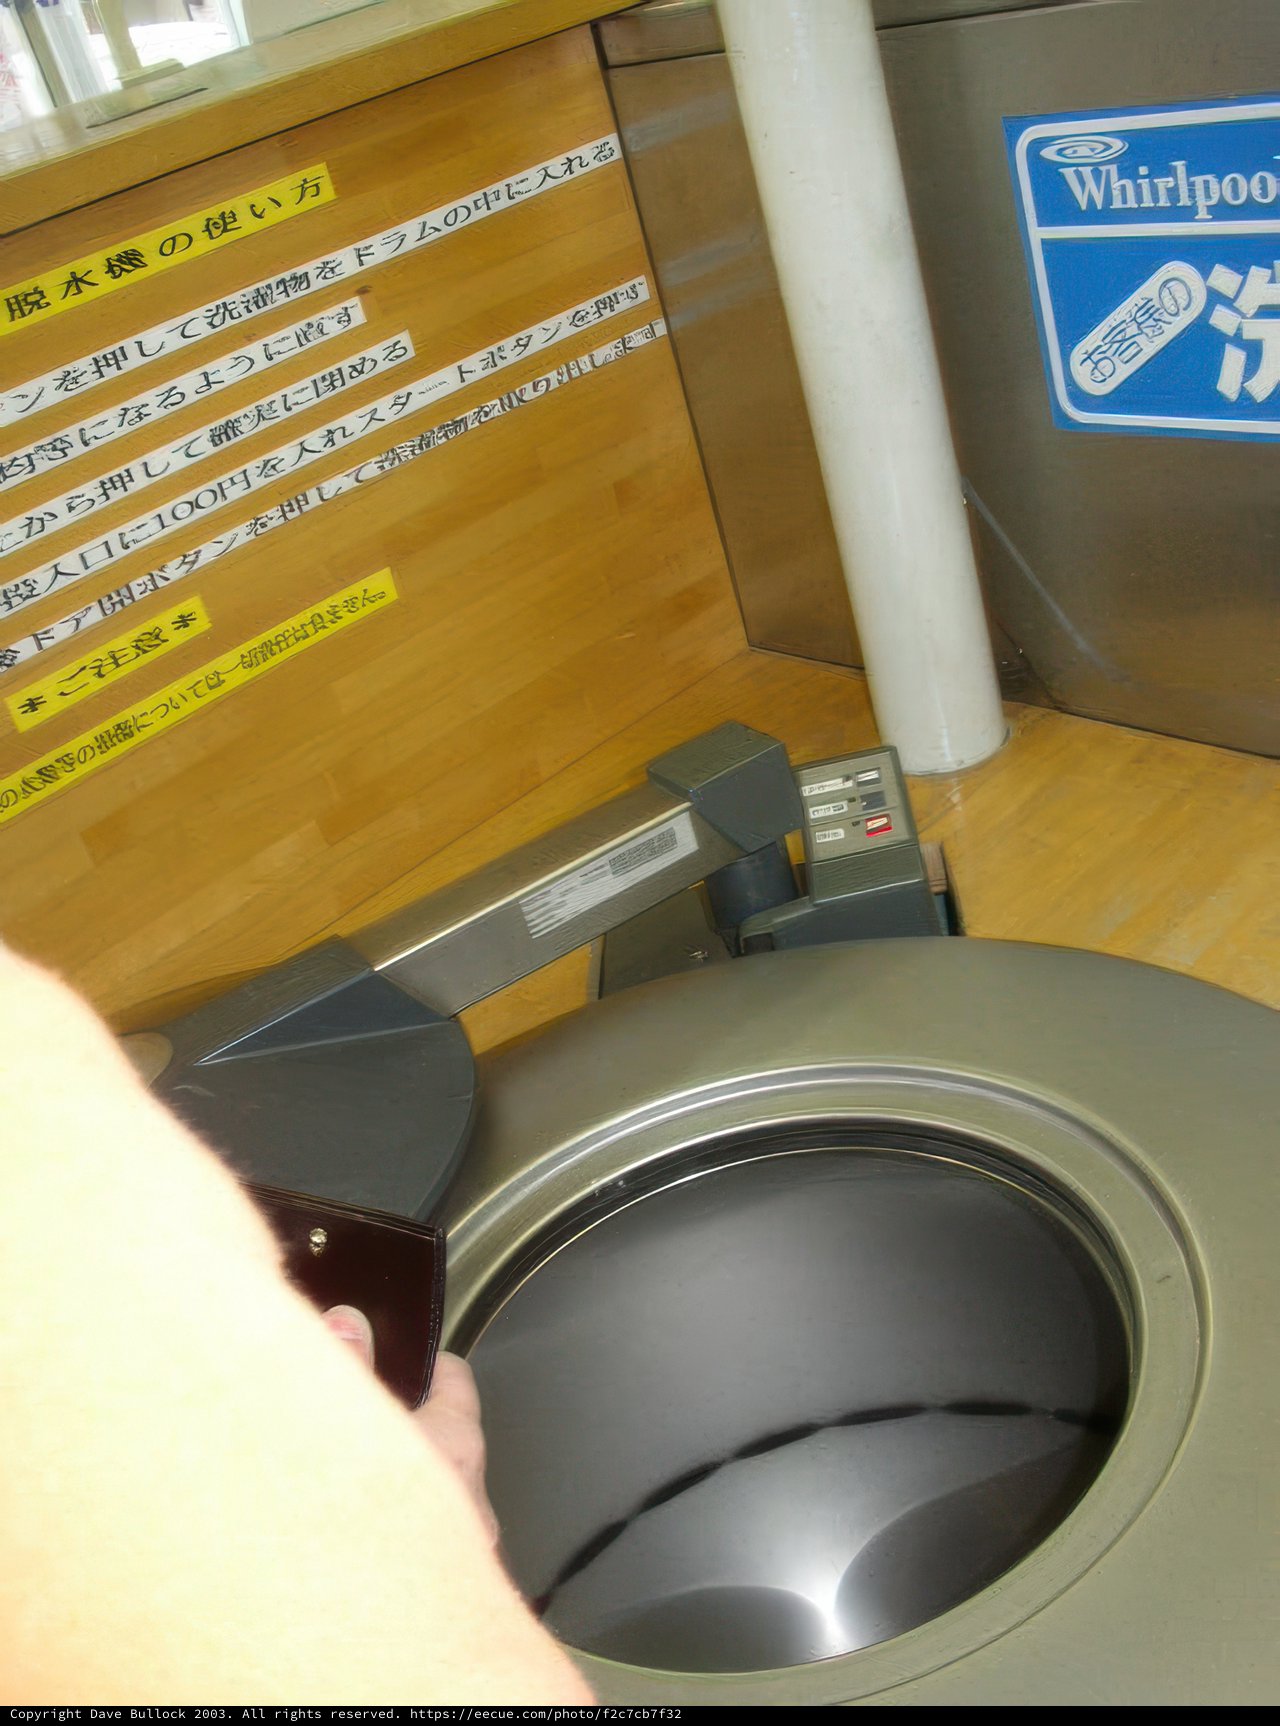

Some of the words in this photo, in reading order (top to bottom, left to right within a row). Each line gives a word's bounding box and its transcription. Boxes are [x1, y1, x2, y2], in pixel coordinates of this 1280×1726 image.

[7, 176, 324, 322] 脱水機の使い方
[1058, 157, 1280, 219] Whirlpoo
[0, 140, 616, 414] ンを押して洗濯物をドラムの中に入れる
